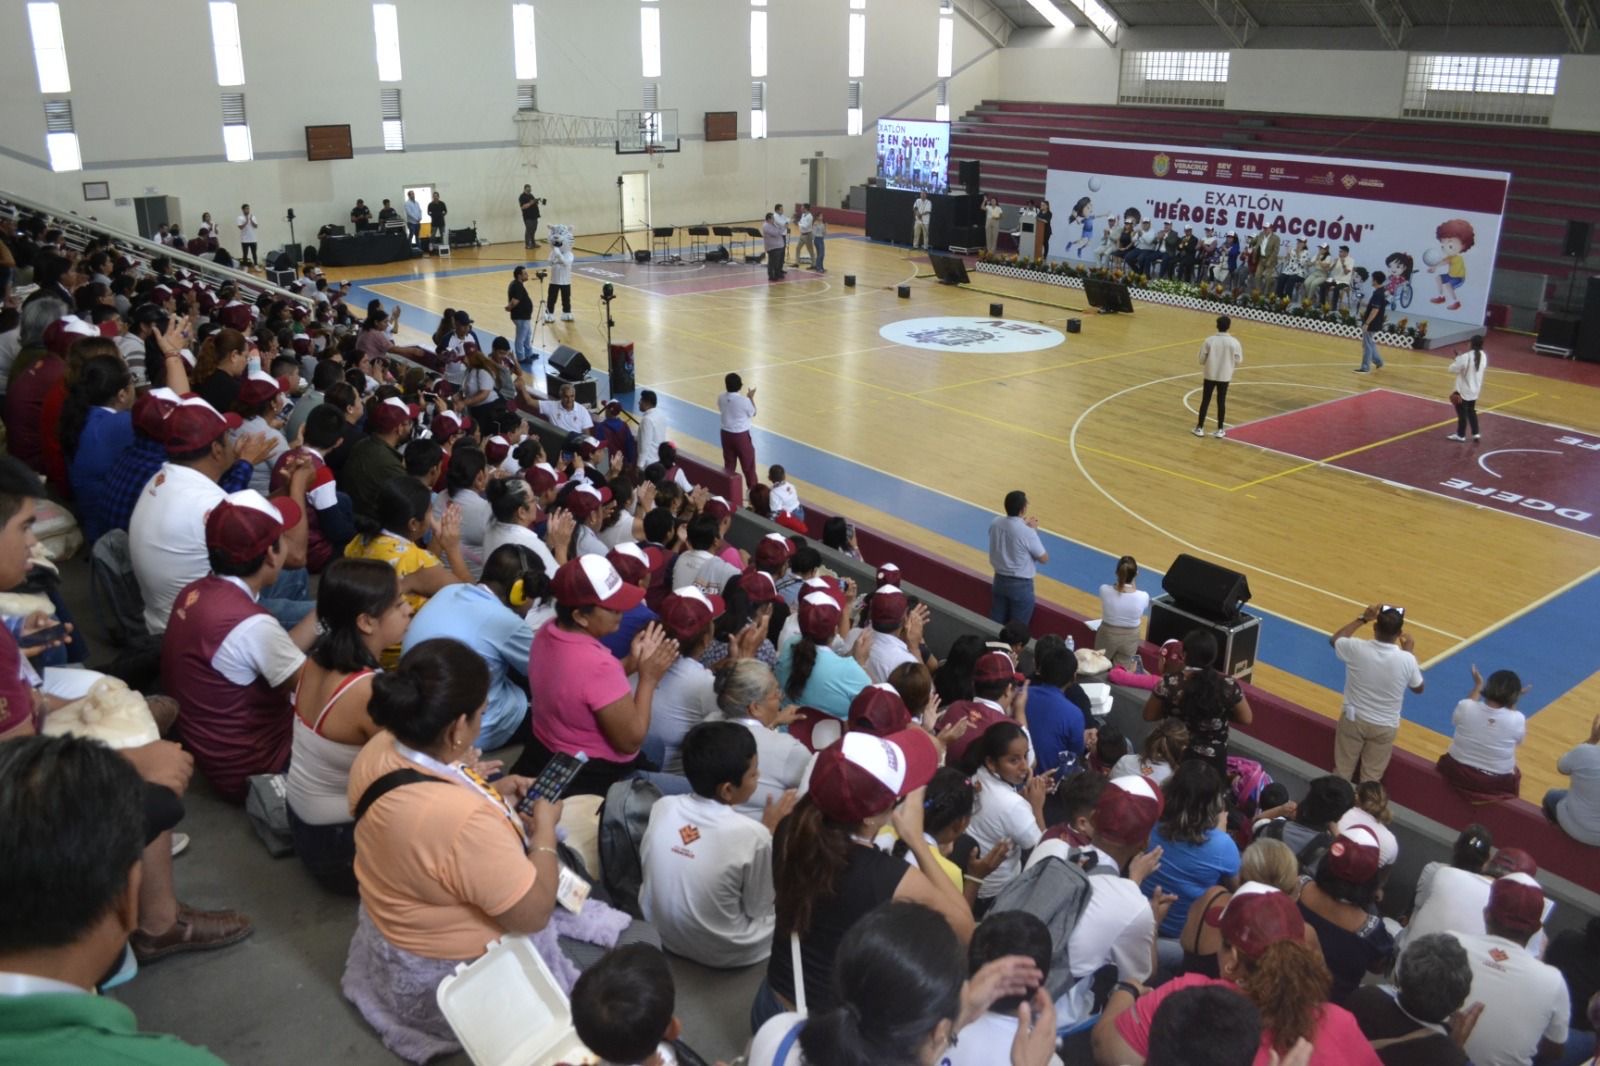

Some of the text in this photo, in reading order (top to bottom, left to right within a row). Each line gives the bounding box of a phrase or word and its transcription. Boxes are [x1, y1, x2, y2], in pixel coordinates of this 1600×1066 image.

[888, 134, 899, 145] EN
[1174, 162, 1208, 171] VERACRUZ
[1205, 191, 1284, 212] EXATLÓN
[1146, 197, 1375, 243] "HÉROES EN ACCIÓN"
[1439, 477, 1593, 521] DGEFE
